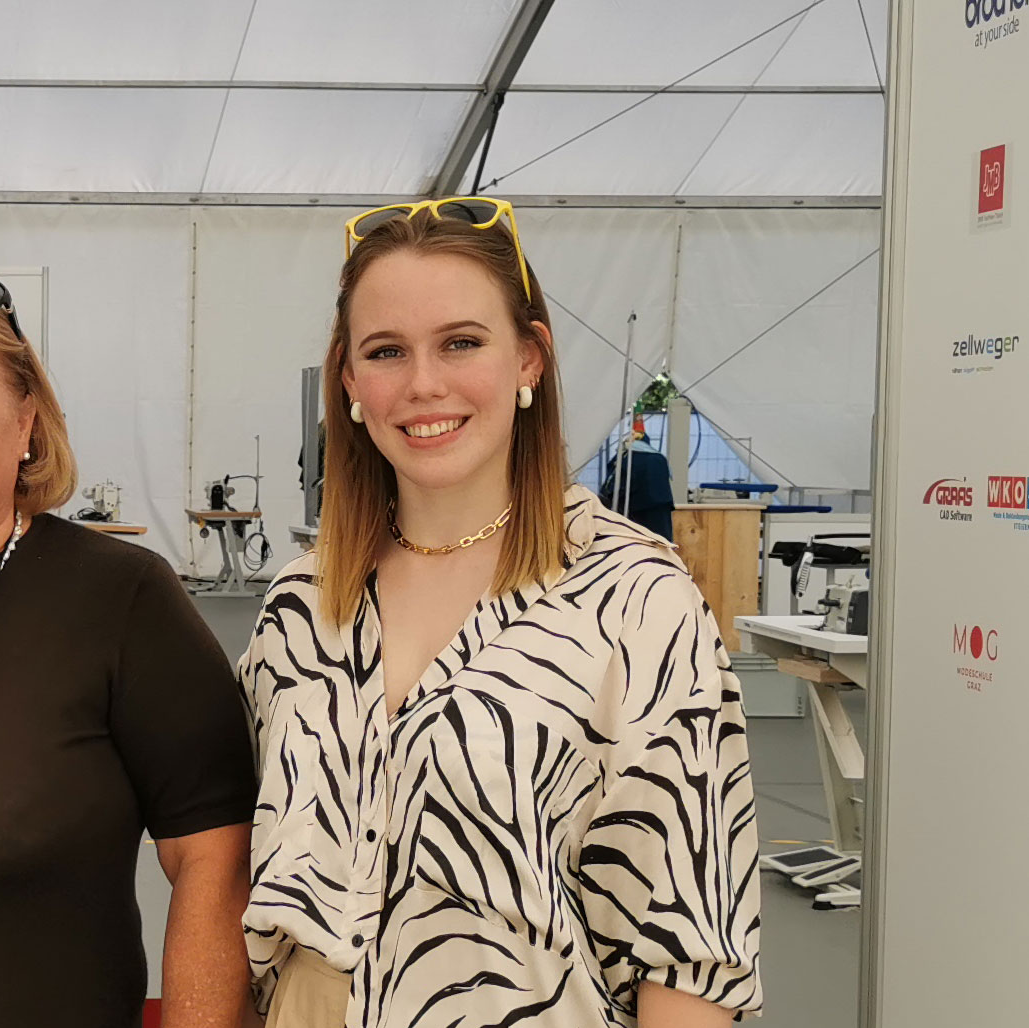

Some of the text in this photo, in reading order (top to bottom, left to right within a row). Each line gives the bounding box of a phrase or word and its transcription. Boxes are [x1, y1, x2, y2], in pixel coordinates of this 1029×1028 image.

[975, 15, 1019, 49] at your side
[952, 333, 1020, 360] zellweger
[988, 479, 1025, 505] WKO
[950, 510, 973, 522] Software
[953, 623, 998, 661] MOG
[957, 666, 993, 682] MODESCHULE
[967, 680, 981, 692] GRAZ
